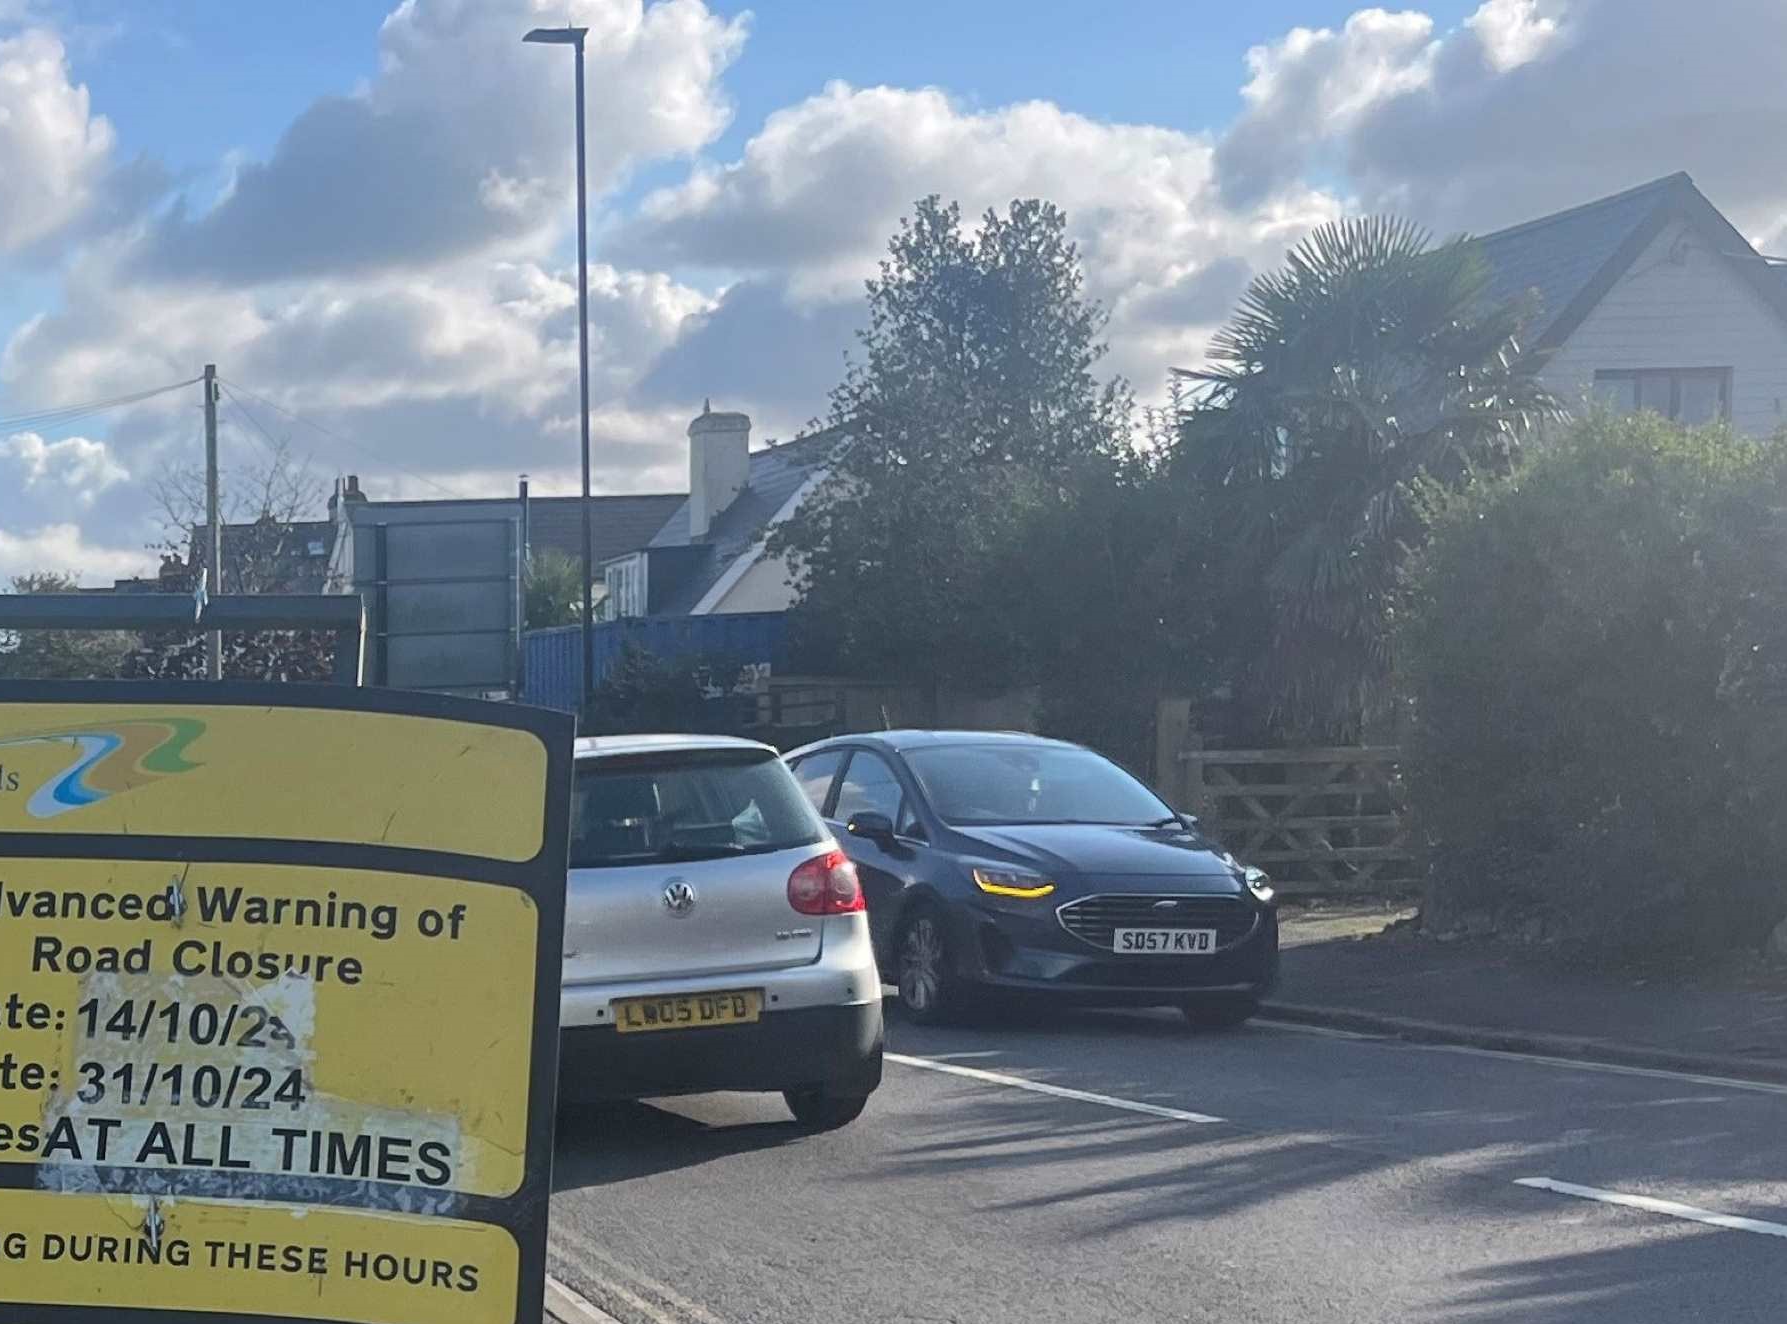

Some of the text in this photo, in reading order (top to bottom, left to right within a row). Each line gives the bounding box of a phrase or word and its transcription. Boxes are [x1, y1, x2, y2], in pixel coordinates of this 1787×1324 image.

[196, 886, 398, 940] Warning
[417, 904, 467, 939] of
[31, 935, 363, 985] Road Closure
[76, 1062, 307, 1112] 31/10/24
[40, 1115, 122, 1160] AT
[135, 1121, 252, 1169] ALL
[271, 1127, 452, 1187] TIMES
[42, 1233, 191, 1267] DURING
[204, 1241, 329, 1275] THESE
[344, 1250, 480, 1293] HOURS
